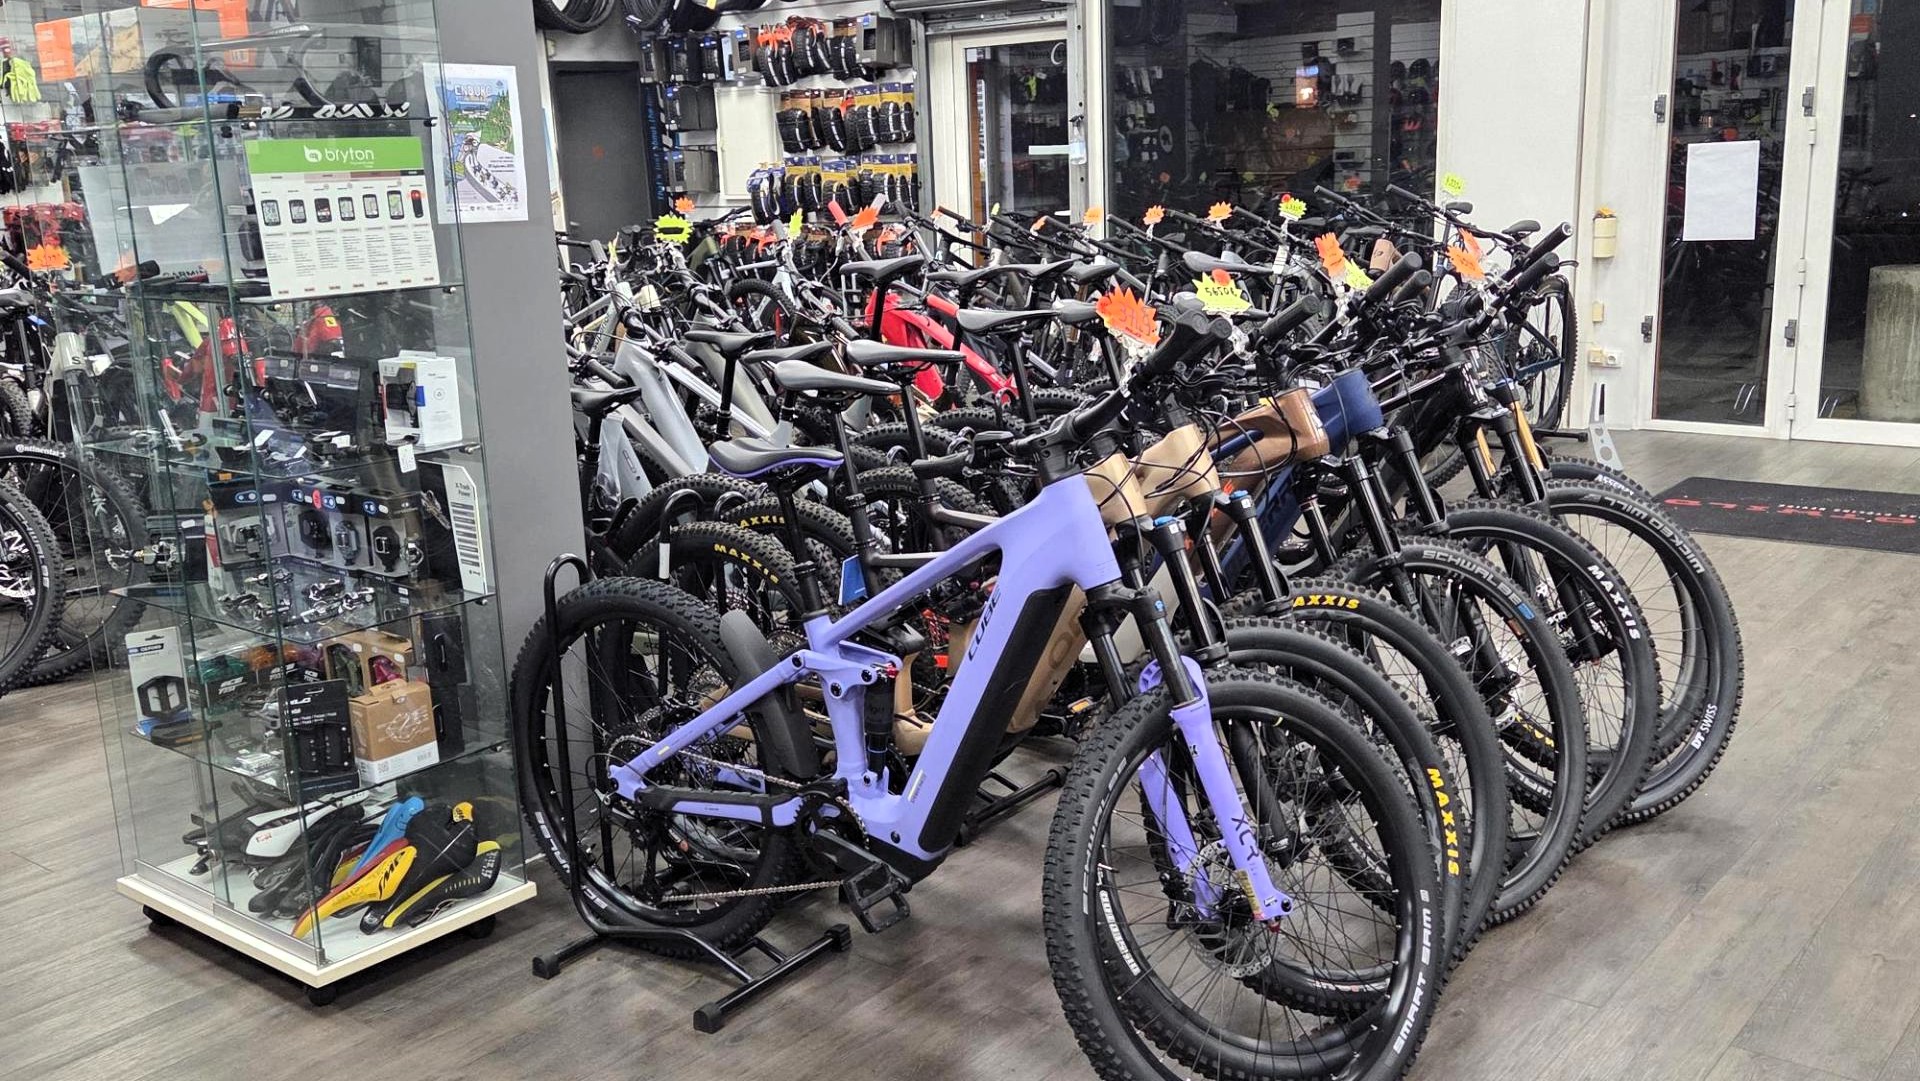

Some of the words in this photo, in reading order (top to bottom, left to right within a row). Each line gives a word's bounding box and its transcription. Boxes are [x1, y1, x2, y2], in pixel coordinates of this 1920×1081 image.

[324, 147, 375, 163] bryton
[864, 484, 918, 494] CHWAL
[1603, 496, 1649, 520] WILL
[713, 543, 780, 584] MAXXIS
[1648, 517, 1706, 575] WICKED
[1292, 594, 1360, 609] AXXIS
[1422, 550, 1522, 606] SCHWALBE
[1587, 565, 1641, 640] MAXXIS
[968, 586, 1002, 661] CUBE
[1691, 732, 1706, 750] DT
[1700, 704, 1718, 734] SWISS
[1427, 767, 1460, 876] MAXXIS
[1392, 971, 1427, 1055] SMART
[1421, 908, 1431, 966] SAM
